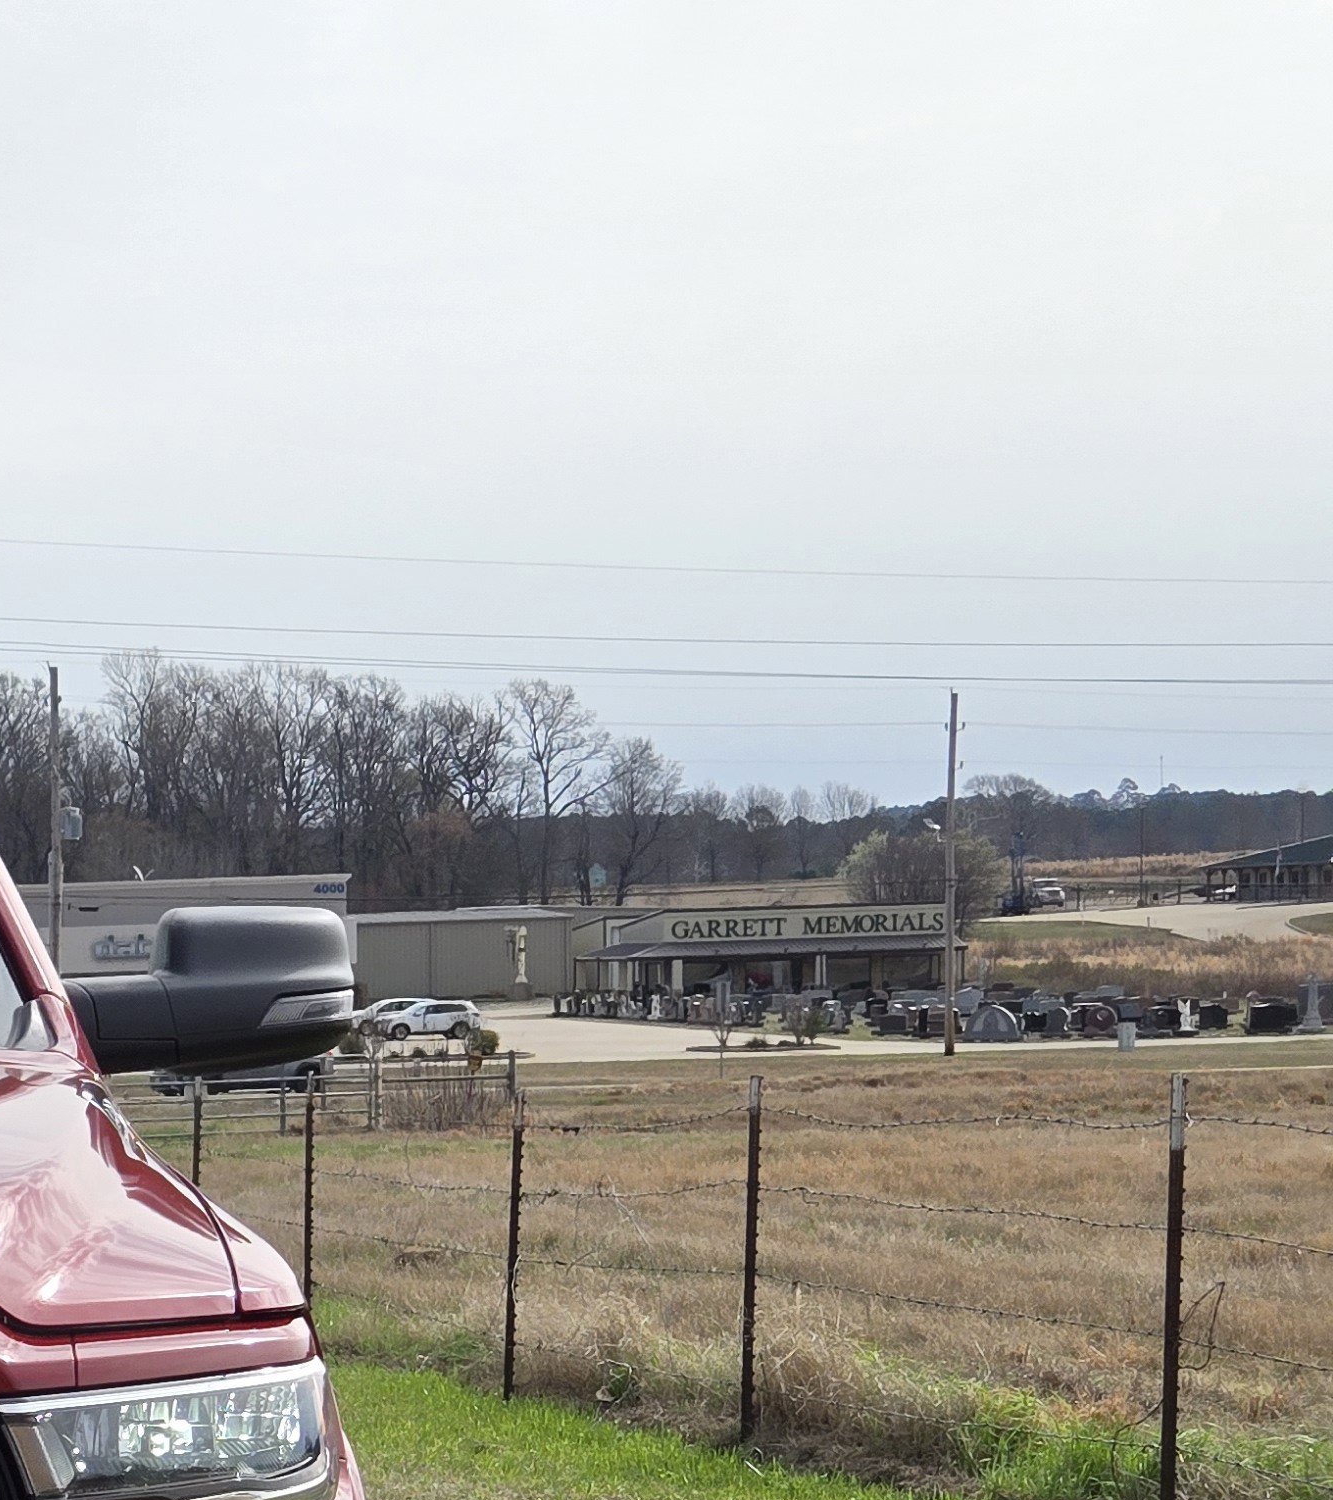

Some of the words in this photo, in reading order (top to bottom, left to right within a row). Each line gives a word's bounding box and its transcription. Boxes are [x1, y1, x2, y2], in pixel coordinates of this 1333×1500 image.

[312, 882, 346, 895] 4000
[670, 917, 787, 940] GARRETT
[802, 912, 945, 937] MEMORIALS
